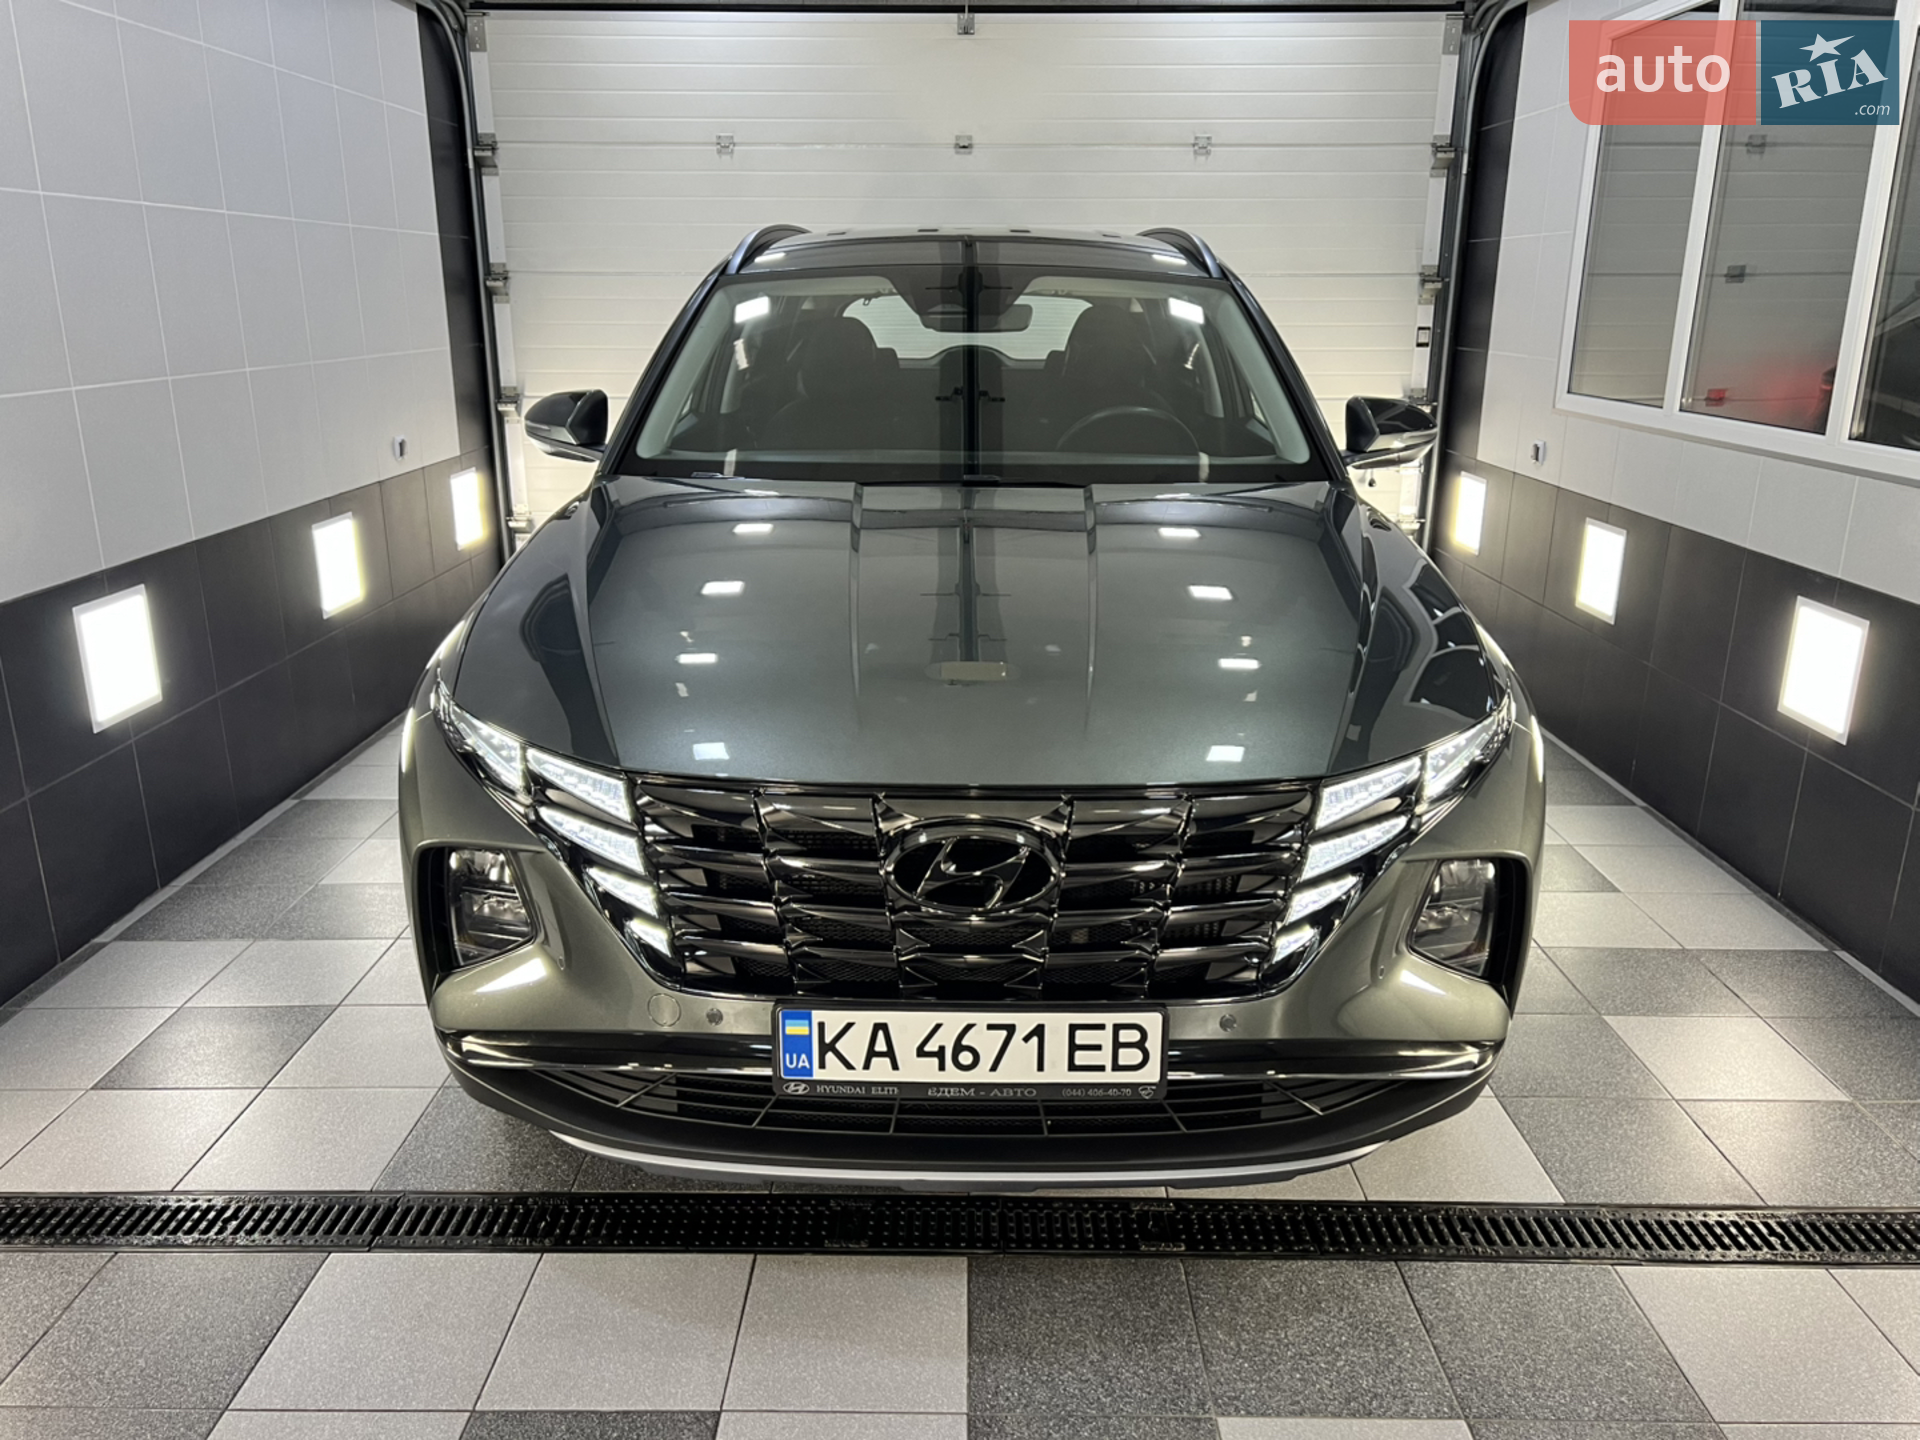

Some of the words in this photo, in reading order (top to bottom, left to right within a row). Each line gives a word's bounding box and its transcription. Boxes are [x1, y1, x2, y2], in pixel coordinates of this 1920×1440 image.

[817, 1021, 900, 1071] KA
[915, 1023, 1046, 1072] 4671
[1067, 1023, 1150, 1072] EB
[785, 1053, 811, 1069] UA
[816, 1085, 866, 1095] HYUNDAI
